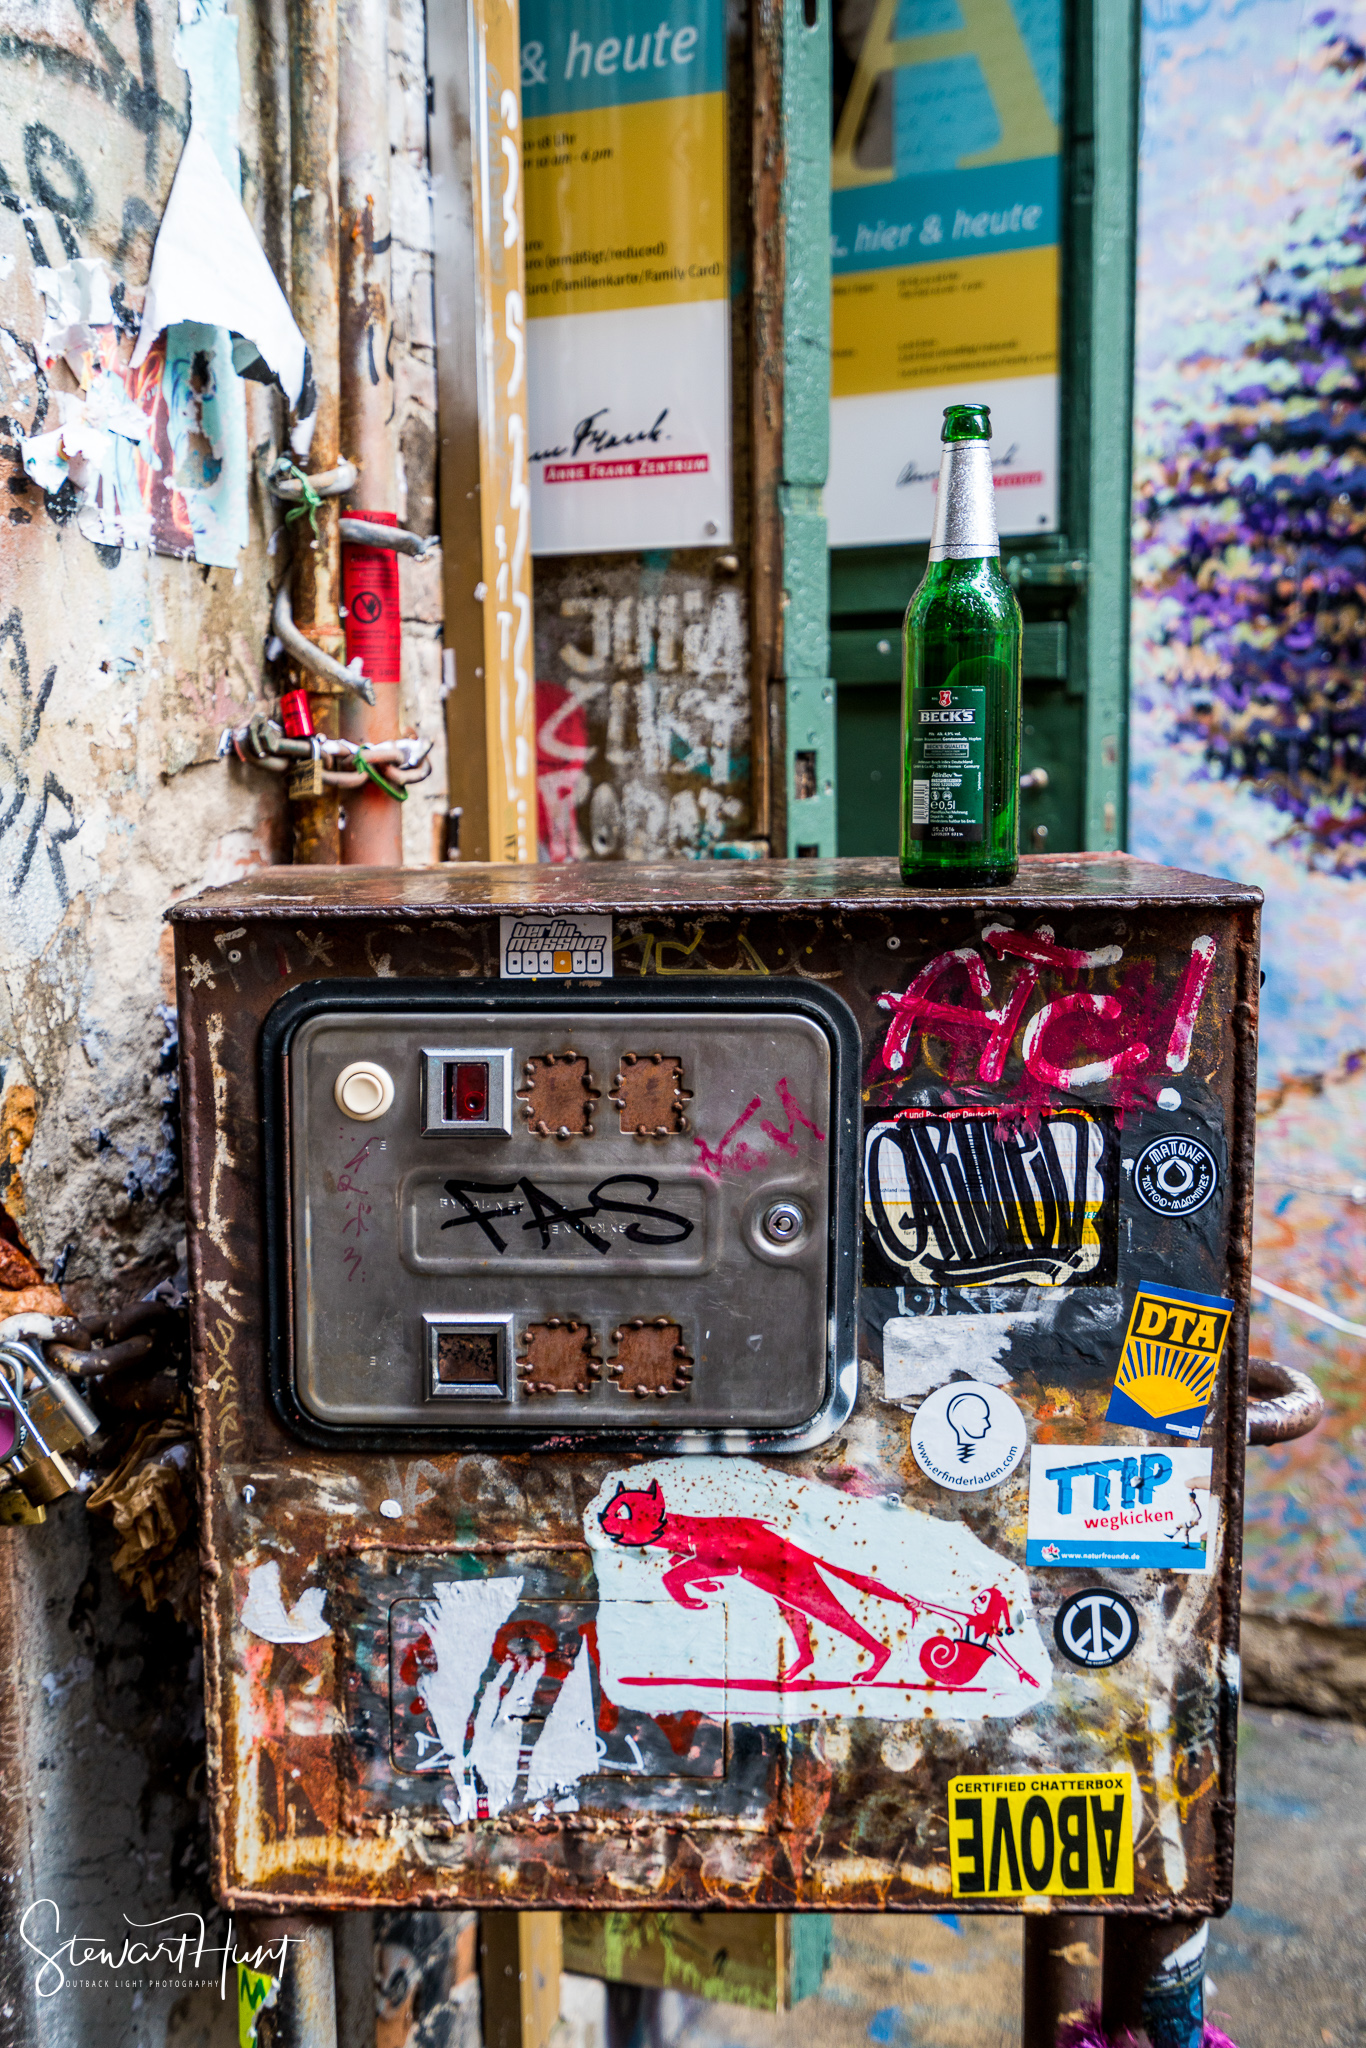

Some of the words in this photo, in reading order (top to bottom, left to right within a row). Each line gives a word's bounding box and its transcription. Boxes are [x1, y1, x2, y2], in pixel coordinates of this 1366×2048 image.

[520, 40, 548, 87] &
[564, 21, 698, 80] heute
[855, 219, 915, 253] hier
[919, 213, 944, 246] &
[952, 202, 1043, 240] heute
[524, 239, 544, 252] uro
[525, 258, 545, 270] uro
[688, 262, 721, 278] Card)
[921, 709, 973, 722] BECK'S
[505, 935, 607, 952] massive
[909, 1110, 924, 1119] und
[1136, 1301, 1219, 1350] DTA
[917, 1440, 1019, 1486] www.erfinderladen.com
[1045, 1453, 1173, 1515] TTIP
[1084, 1509, 1174, 1531] wegkicken
[1061, 1551, 1141, 1561] www.naturfreunde.de
[955, 1781, 1027, 1793] CERTIFIED
[1030, 1778, 1124, 1792] CHATTERBOX
[954, 1794, 1125, 1893] ABOVE
